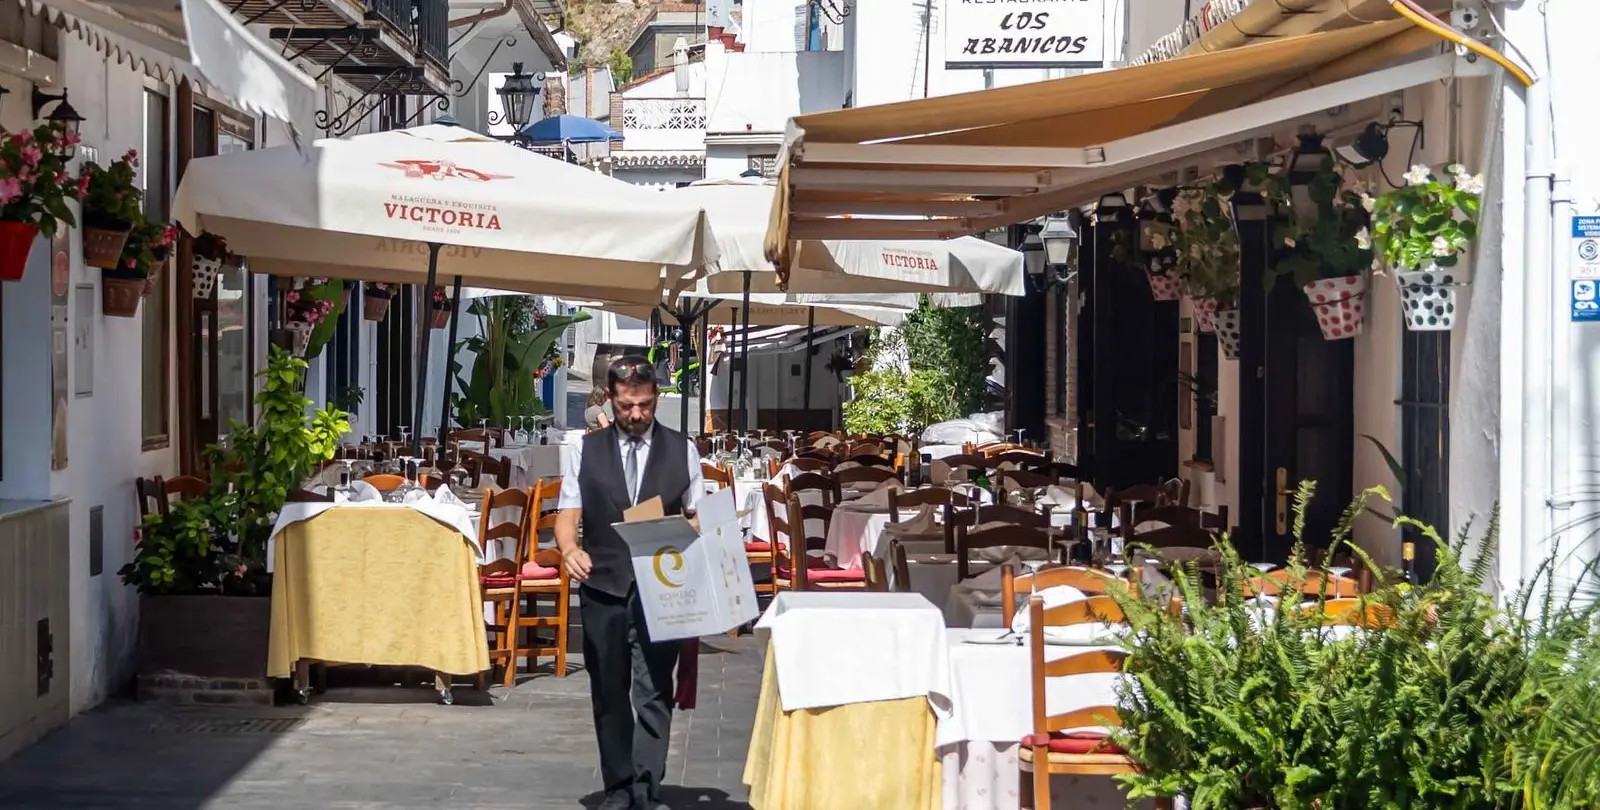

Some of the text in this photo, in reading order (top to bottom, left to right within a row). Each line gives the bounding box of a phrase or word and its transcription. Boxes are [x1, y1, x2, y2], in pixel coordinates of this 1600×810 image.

[1000, 11, 1050, 30] LOS
[962, 35, 1088, 54] ABANICOS
[383, 202, 502, 230] VICTORIA
[881, 252, 938, 270] VICTORIA
